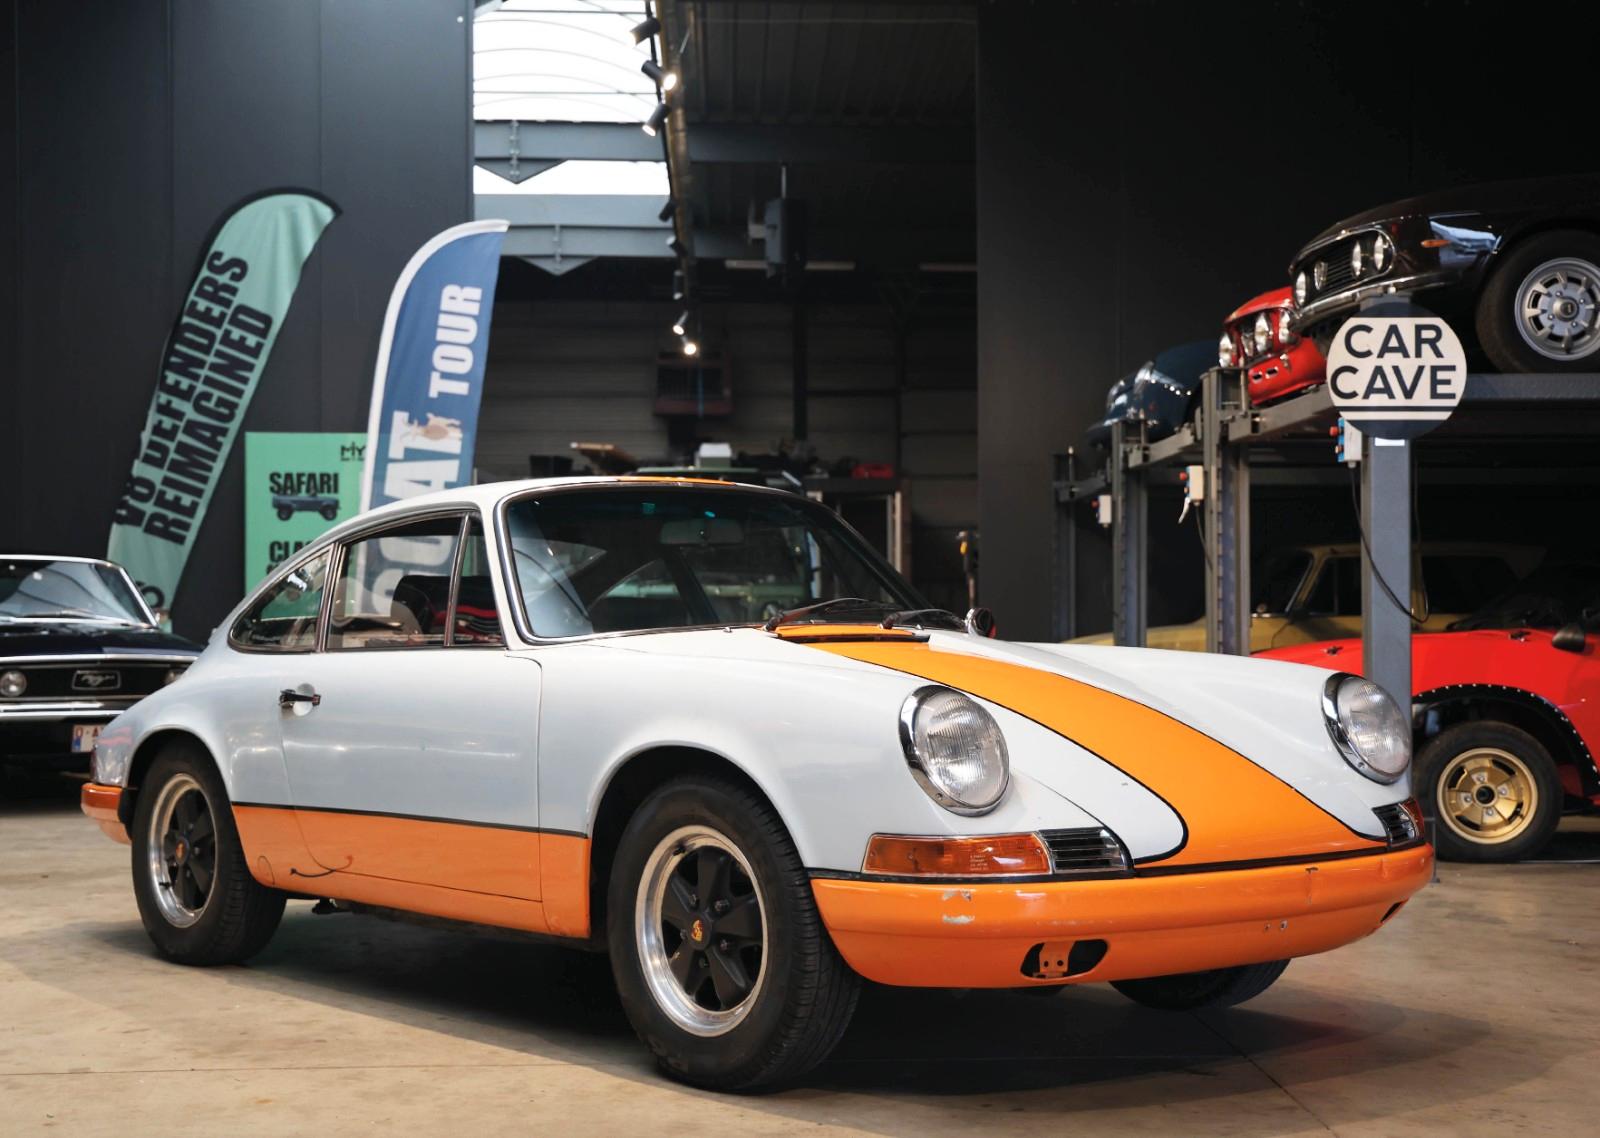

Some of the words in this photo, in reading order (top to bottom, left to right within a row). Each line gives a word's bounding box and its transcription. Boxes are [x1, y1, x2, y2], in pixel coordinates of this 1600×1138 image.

[142, 251, 248, 469] DEFENDERS
[429, 284, 482, 398] TOUR
[1344, 324, 1444, 358] CAR
[1330, 365, 1456, 399] CAVE
[143, 304, 273, 545] REIMAGINED
[269, 472, 339, 494] SAFARI
